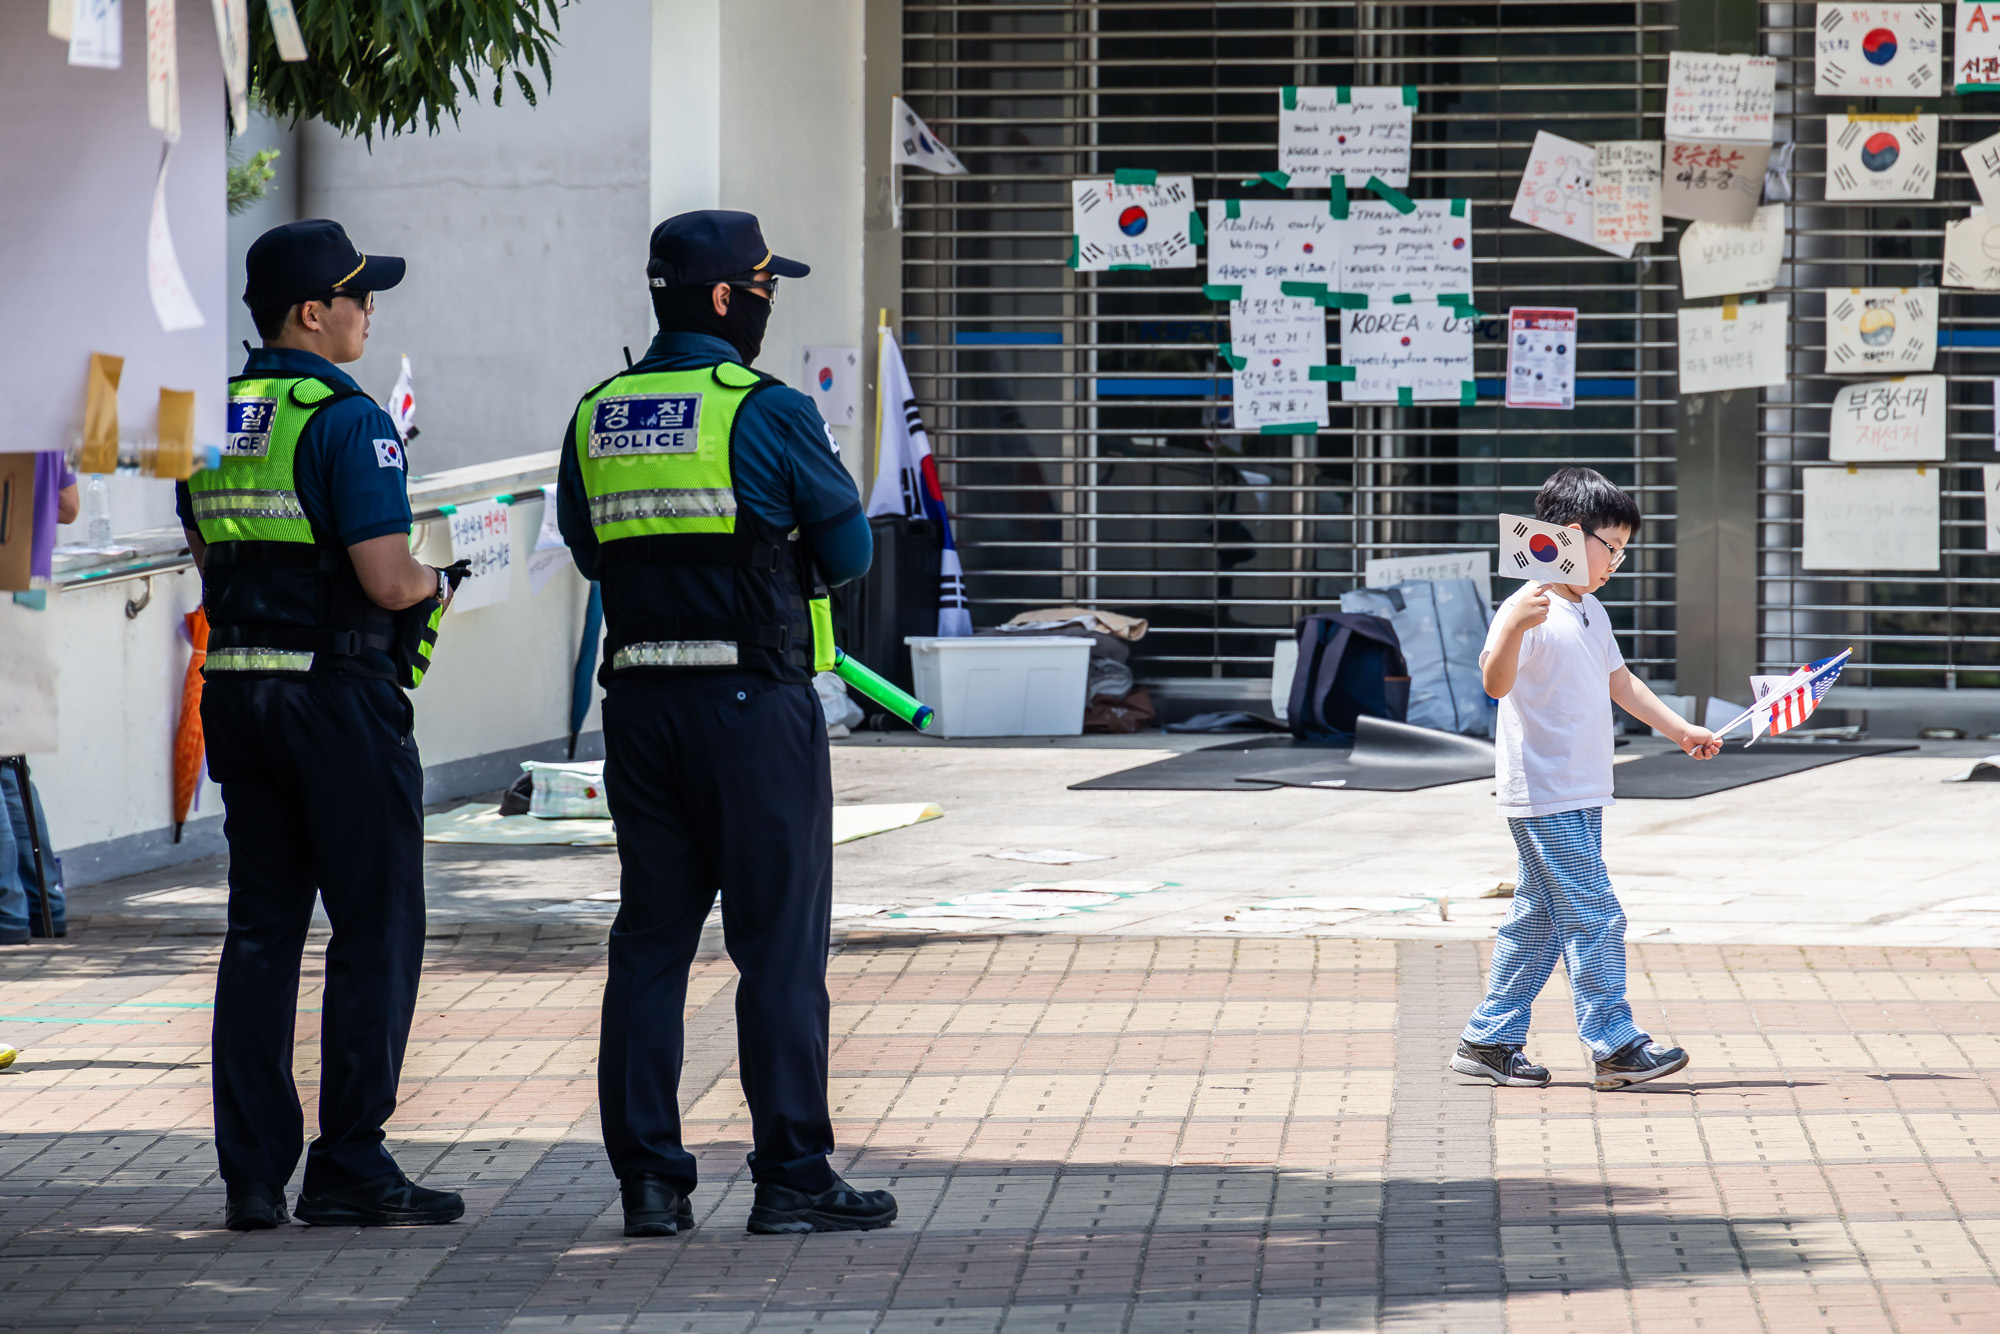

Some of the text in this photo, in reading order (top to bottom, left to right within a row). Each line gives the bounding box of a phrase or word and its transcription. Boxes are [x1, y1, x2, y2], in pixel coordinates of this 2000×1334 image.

[1288, 214, 1327, 234] early
[1350, 312, 1420, 334] KOREA
[604, 401, 688, 430] 경찰
[1847, 386, 1928, 422] 부정선거
[241, 404, 266, 431] 찰
[226, 436, 260, 450] ICE
[600, 432, 685, 451] POLICE
[1855, 424, 1920, 453] 재선거
